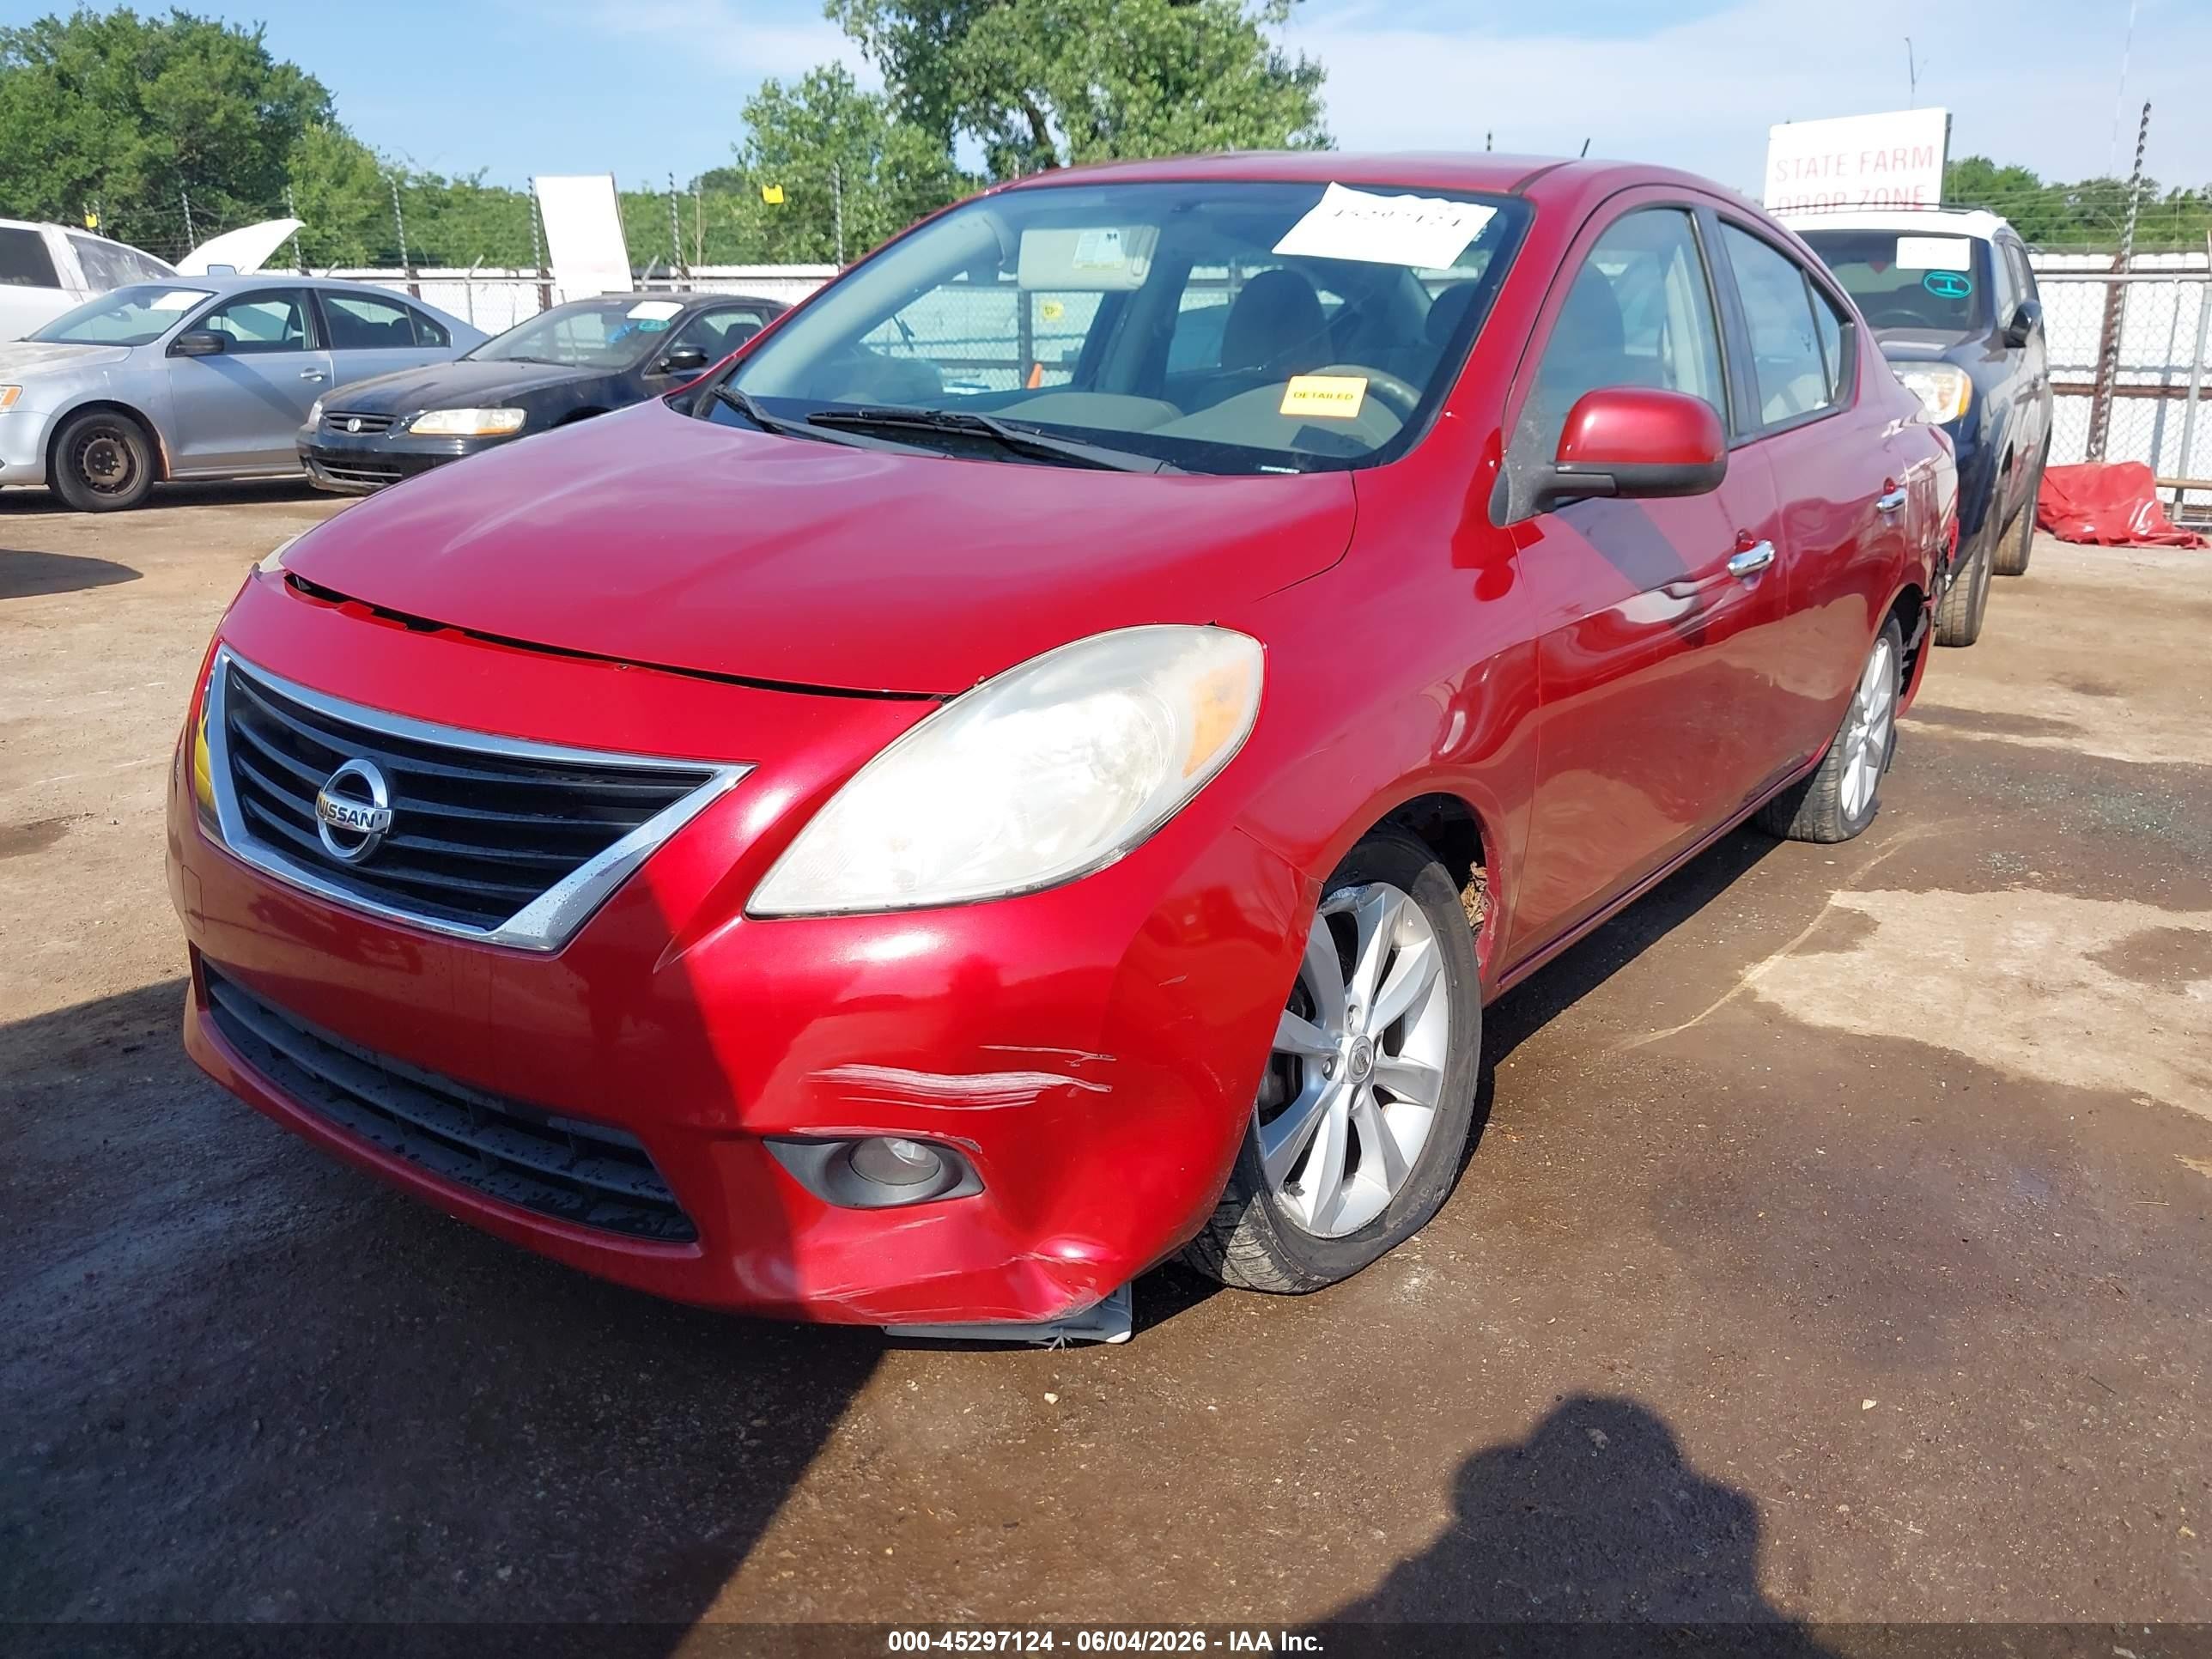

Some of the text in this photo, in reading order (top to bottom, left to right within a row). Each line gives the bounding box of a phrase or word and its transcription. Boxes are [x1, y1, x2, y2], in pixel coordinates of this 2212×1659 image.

[1775, 144, 1934, 182] STATE FARM
[1293, 391, 1354, 401] DETAILED
[317, 797, 375, 829] NISSAN
